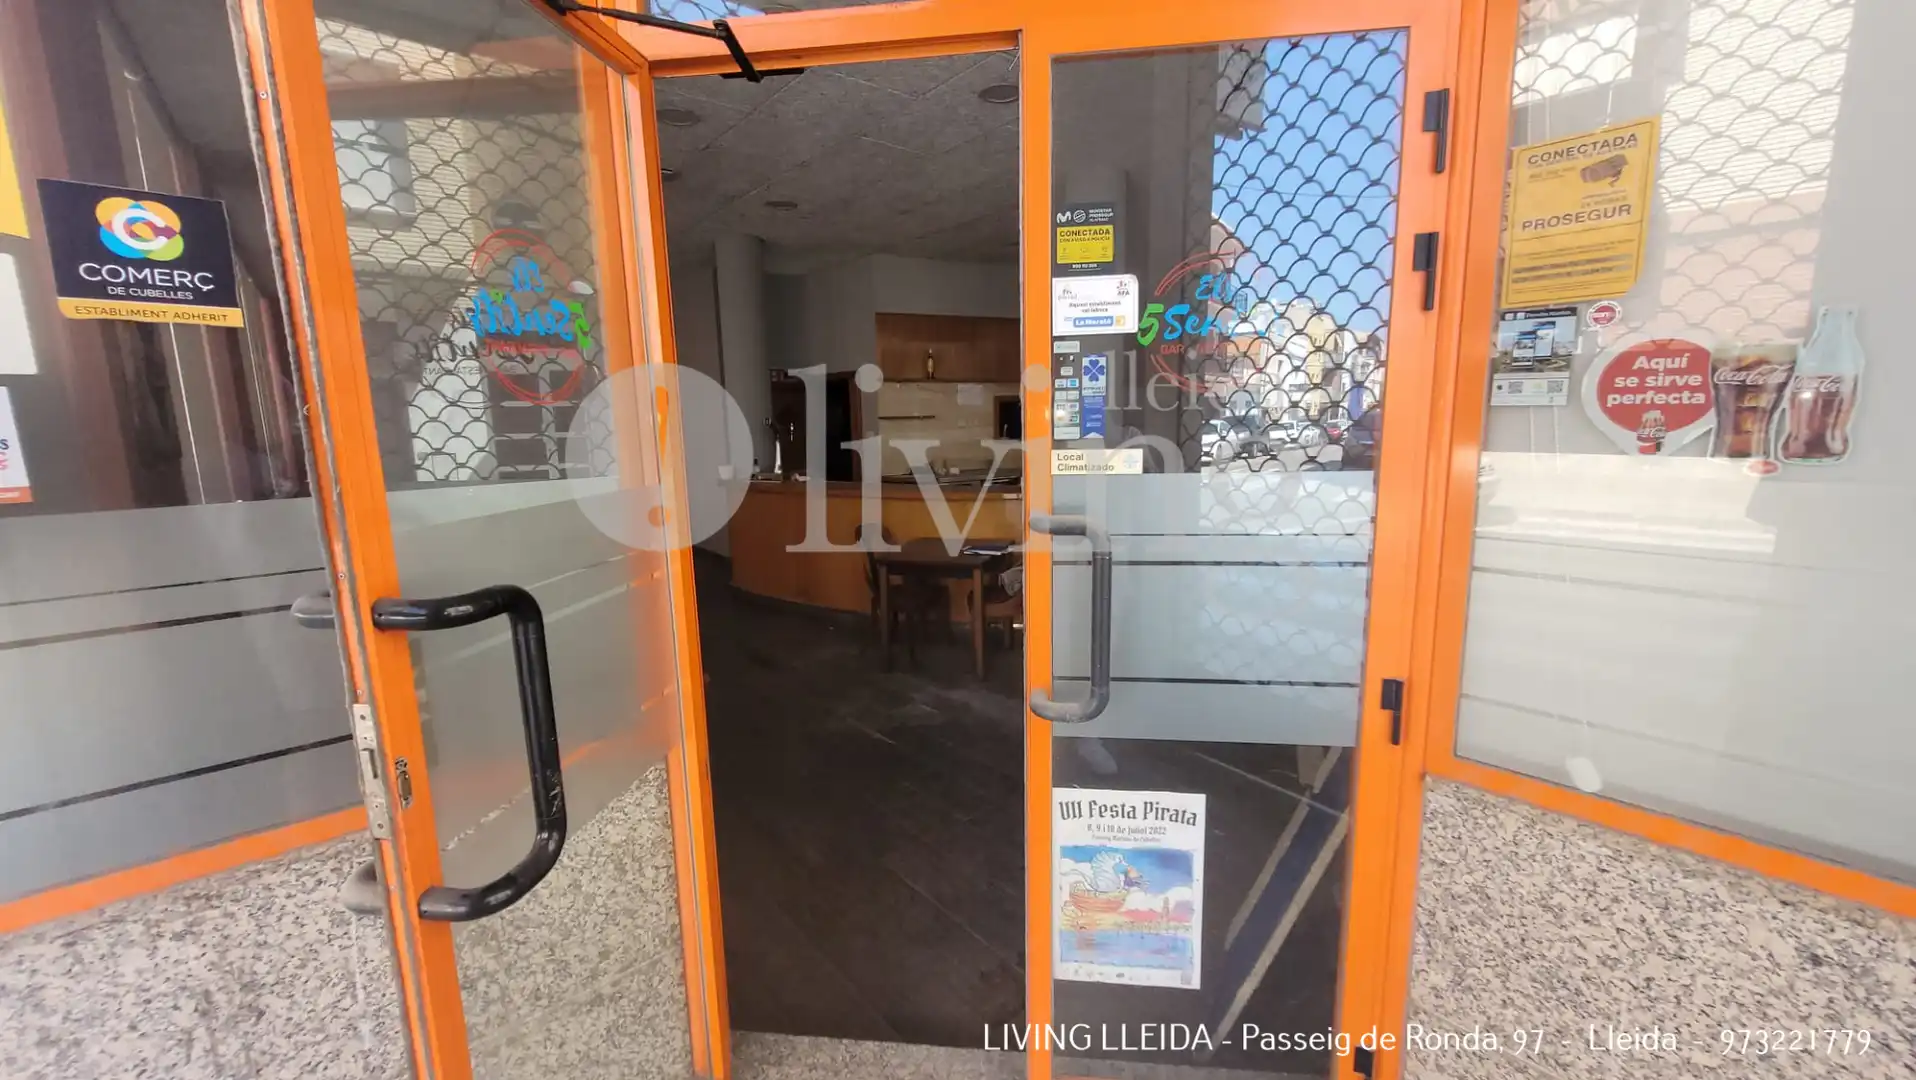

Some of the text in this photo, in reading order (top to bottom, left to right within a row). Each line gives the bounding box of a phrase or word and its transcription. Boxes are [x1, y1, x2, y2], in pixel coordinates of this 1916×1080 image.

[1527, 132, 1639, 166] CONECTADA
[1522, 203, 1632, 233] PROSEGUR
[1059, 228, 1110, 237] CONECTADA
[78, 262, 216, 291] COMERÇ
[107, 286, 193, 300] DE CUBELLES
[74, 305, 228, 323] ESTABLIMENT ADHERIT
[1632, 352, 1691, 374] Aquí
[1614, 373, 1703, 388] se sirve
[1606, 390, 1706, 408] perfecta
[1057, 452, 1084, 461] Local
[1057, 463, 1115, 472] Climatizado
[1088, 799, 1137, 820] Festa
[1142, 801, 1197, 827] Pirata
[1116, 824, 1126, 834] de
[1148, 826, 1167, 836] 2022
